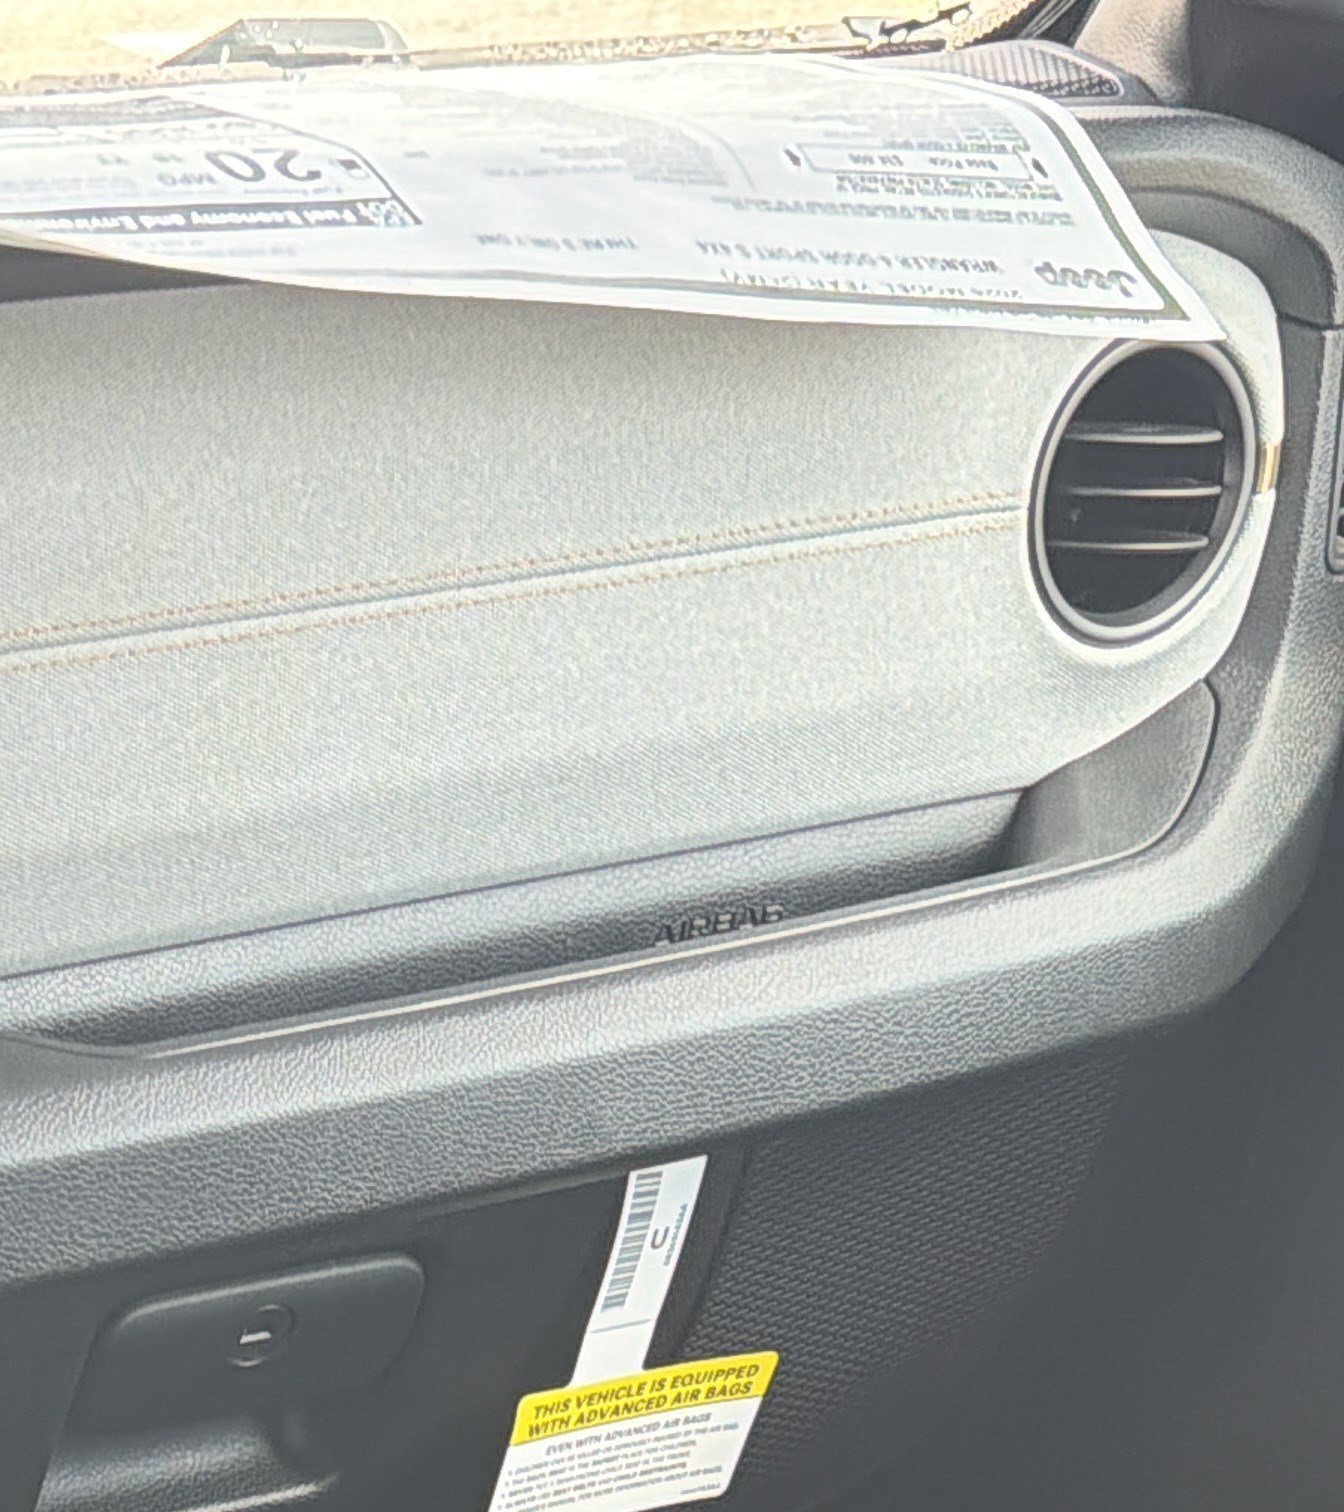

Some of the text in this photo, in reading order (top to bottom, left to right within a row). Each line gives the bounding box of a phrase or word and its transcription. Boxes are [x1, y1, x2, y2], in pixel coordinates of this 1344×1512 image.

[205, 147, 323, 184] 20
[1034, 258, 1138, 299] Jeep
[526, 1380, 753, 1440] WITH ADVANCED AIR BAGS
[532, 1363, 761, 1422] THIS VEHICLE IS EQUIPPED
[572, 1433, 603, 1451] WITH
[602, 1421, 661, 1445] ADVANCED
